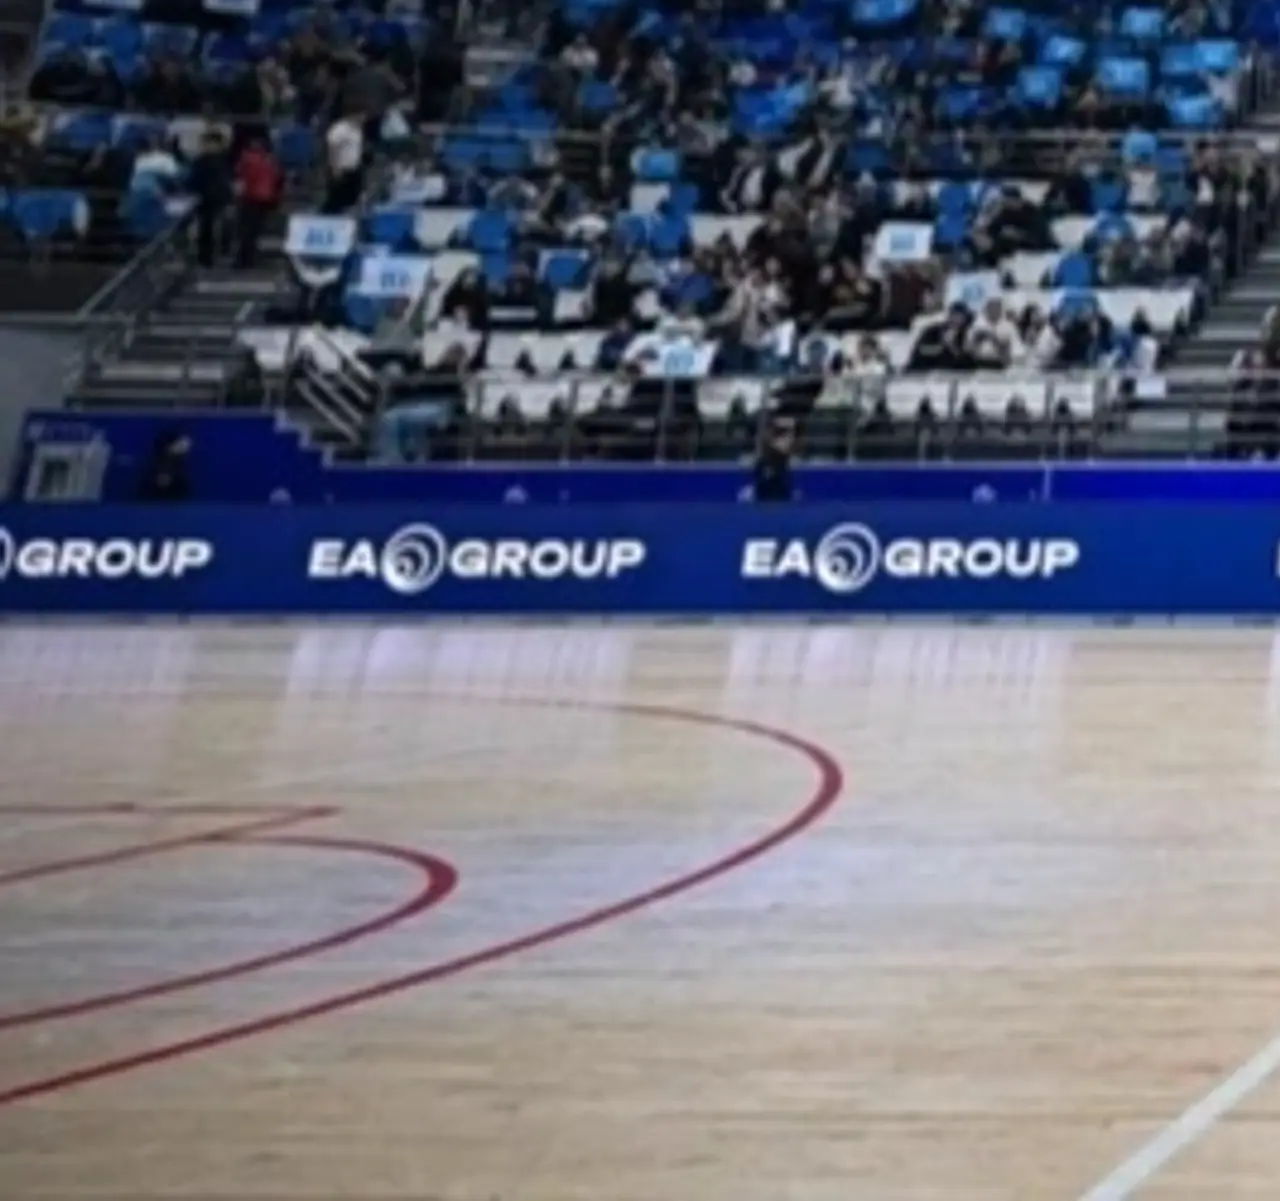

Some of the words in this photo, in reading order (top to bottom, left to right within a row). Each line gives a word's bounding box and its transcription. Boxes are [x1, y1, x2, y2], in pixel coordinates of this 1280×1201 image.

[15, 539, 213, 577] GROUP
[307, 539, 379, 577] EA
[447, 539, 647, 577] GROUP
[741, 539, 812, 577] EA
[883, 539, 1080, 577] GROUP
